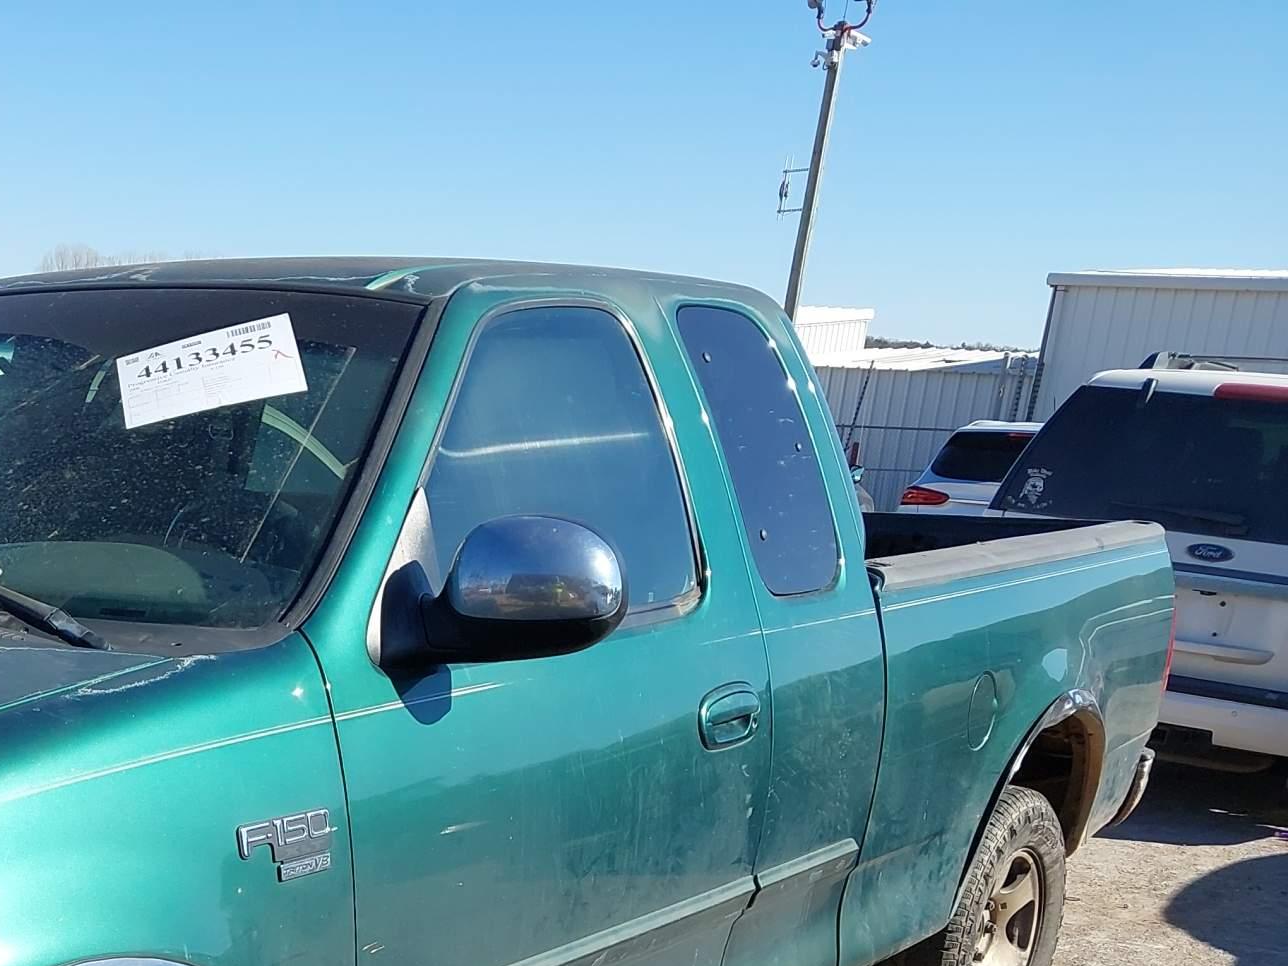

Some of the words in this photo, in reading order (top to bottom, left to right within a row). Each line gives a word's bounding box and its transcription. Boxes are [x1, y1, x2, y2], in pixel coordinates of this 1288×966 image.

[137, 334, 273, 380] 44133455
[1194, 545, 1223, 559] Ford
[314, 855, 330, 871] V8
